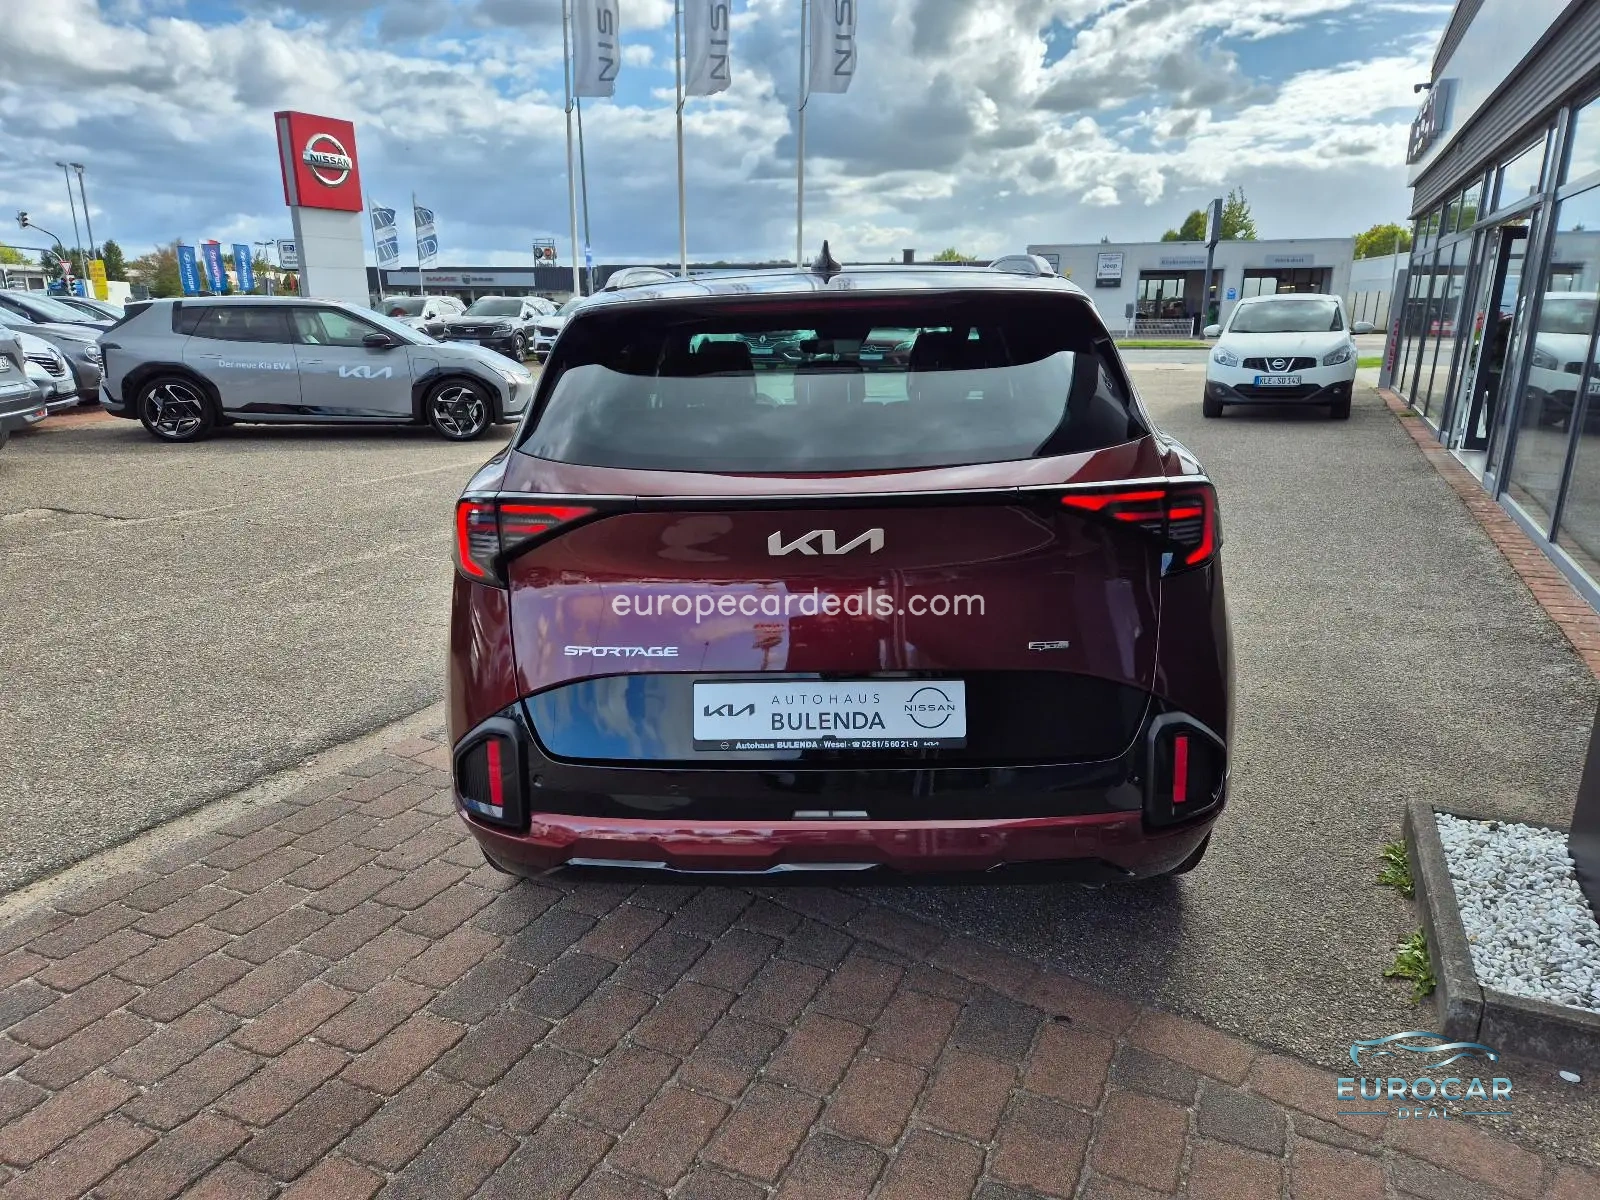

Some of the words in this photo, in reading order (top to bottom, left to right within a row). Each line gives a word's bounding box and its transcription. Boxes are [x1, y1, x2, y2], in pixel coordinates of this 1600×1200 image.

[310, 154, 350, 167] NISSAN
[218, 359, 234, 368] Der
[236, 361, 257, 369] neue
[258, 361, 272, 369] Kia
[338, 365, 393, 379] KIA
[767, 528, 885, 556] KIA
[564, 645, 679, 657] SPORTAGE
[771, 693, 881, 705] AUTOHAUS
[703, 703, 756, 717] KIA
[904, 704, 956, 712] NISSAN
[771, 711, 887, 731] BULENDA
[736, 741, 775, 749] Autohaus
[776, 741, 818, 749] BULENDA
[823, 740, 848, 748] Wesel
